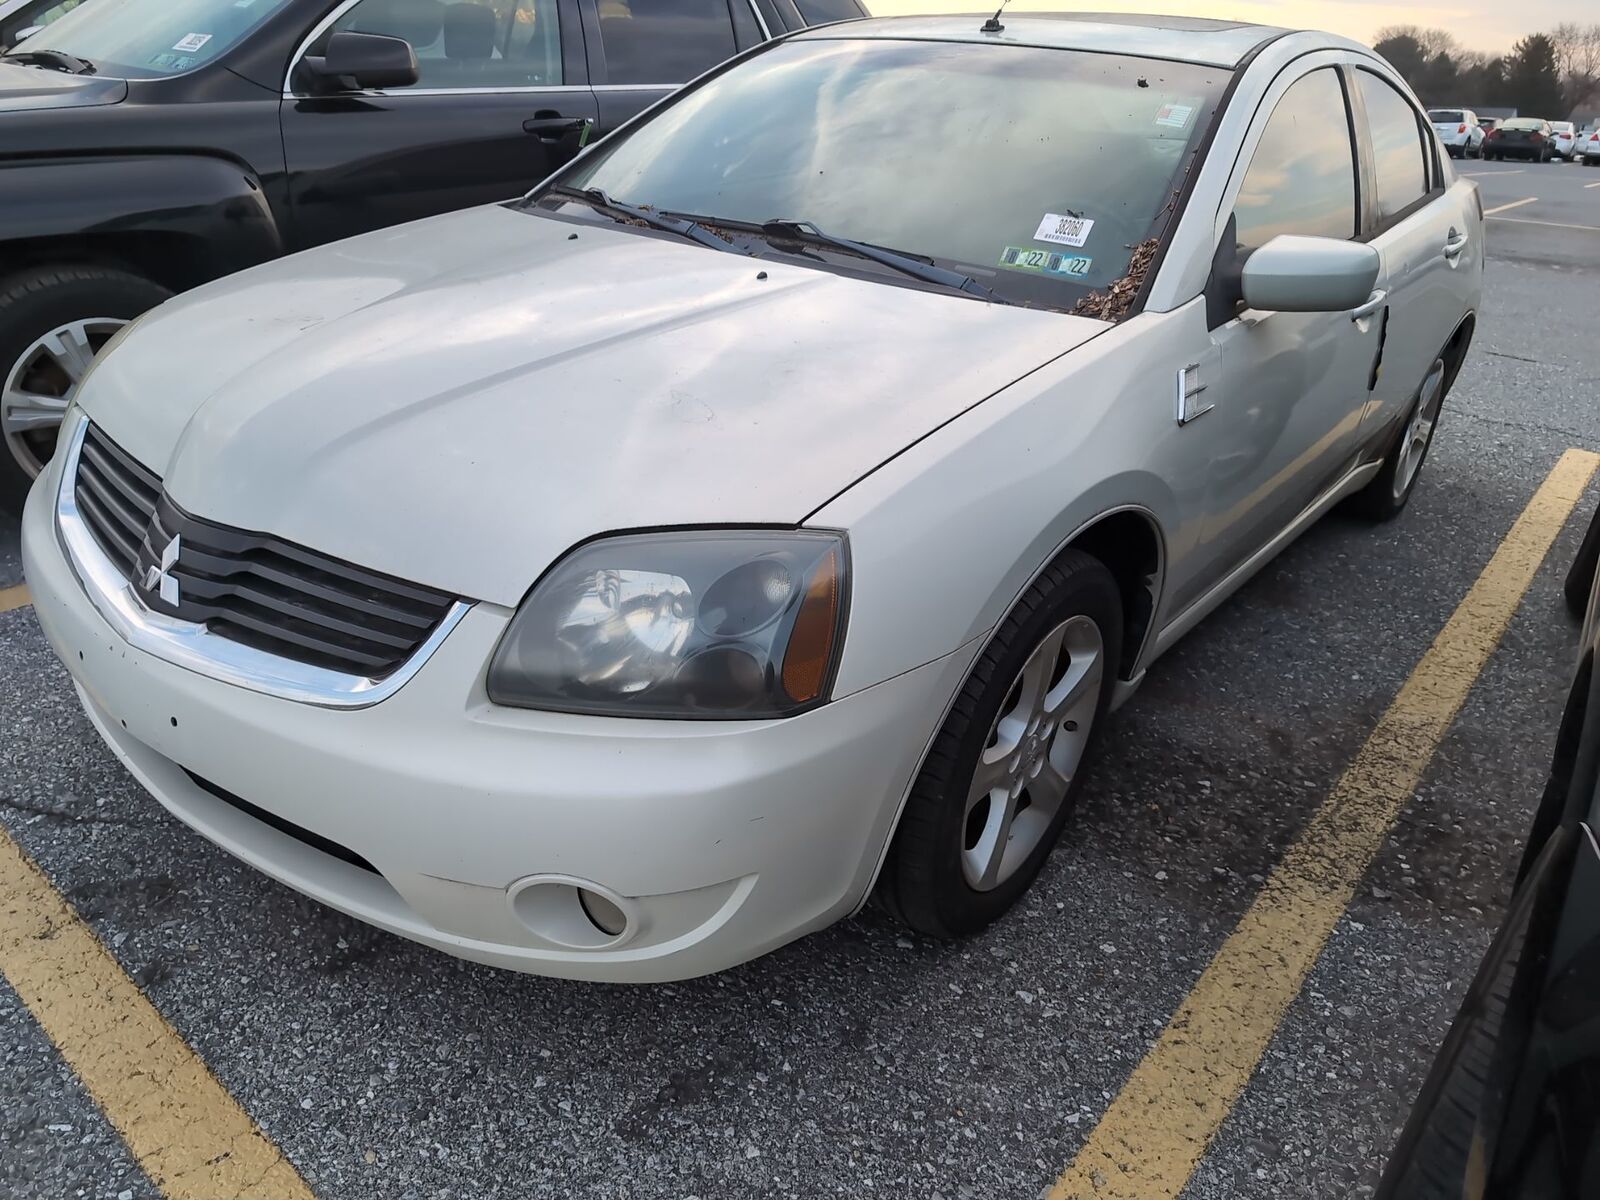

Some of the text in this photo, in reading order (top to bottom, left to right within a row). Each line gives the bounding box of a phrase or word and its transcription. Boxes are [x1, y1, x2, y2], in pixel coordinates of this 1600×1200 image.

[1054, 218, 1084, 237] 382060
[1028, 251, 1043, 267] 22
[1071, 258, 1087, 273] 22
